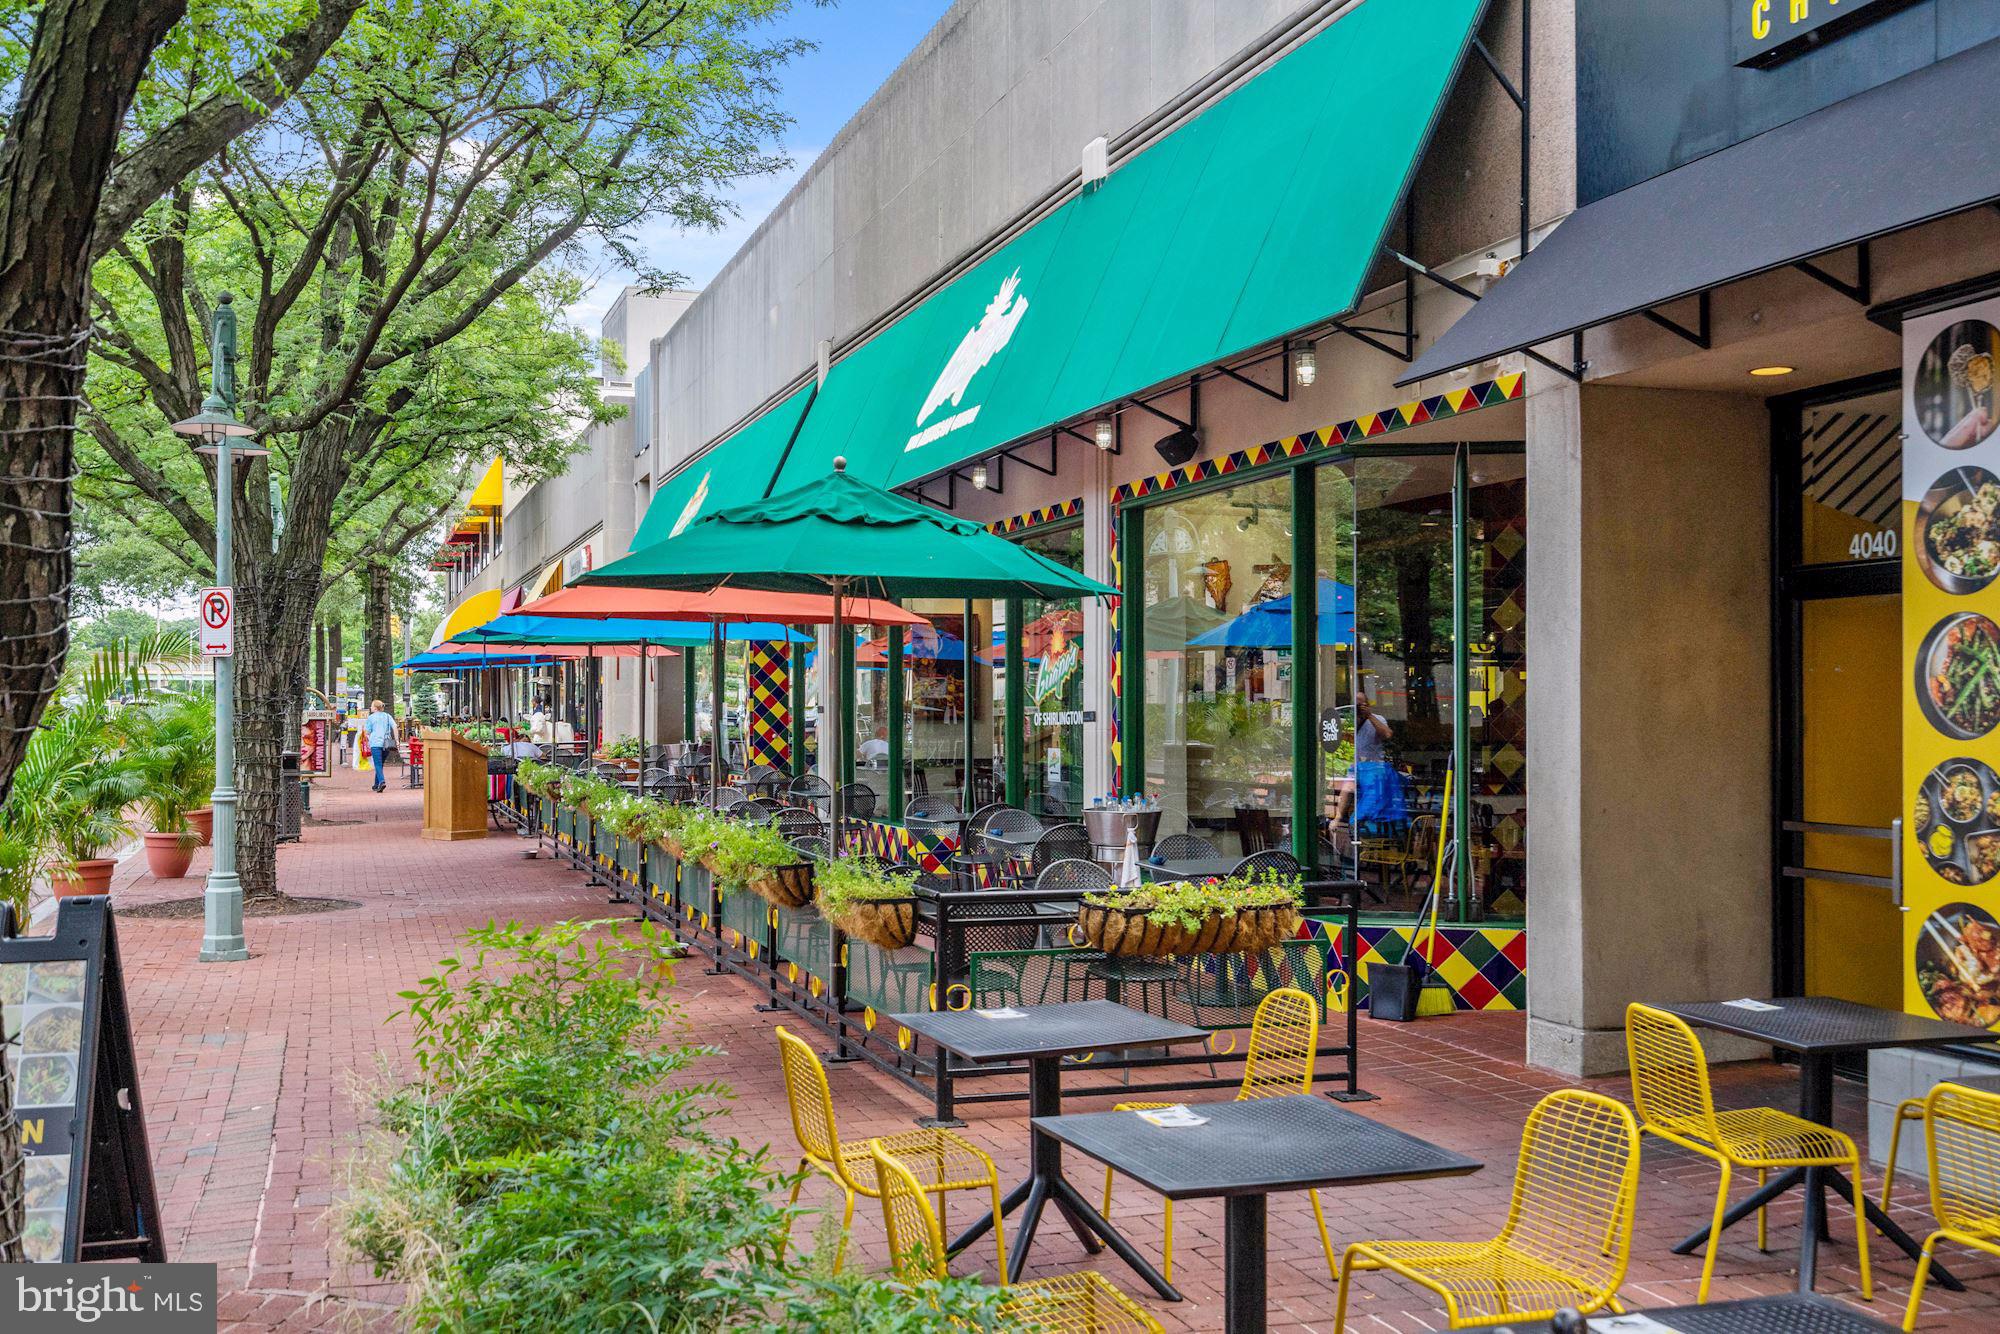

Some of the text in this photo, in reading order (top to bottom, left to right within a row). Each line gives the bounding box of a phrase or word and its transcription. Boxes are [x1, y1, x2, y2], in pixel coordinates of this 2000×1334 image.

[1848, 529, 1897, 560] 4040
[1034, 711, 1084, 726] OF SHIRLINGTON
